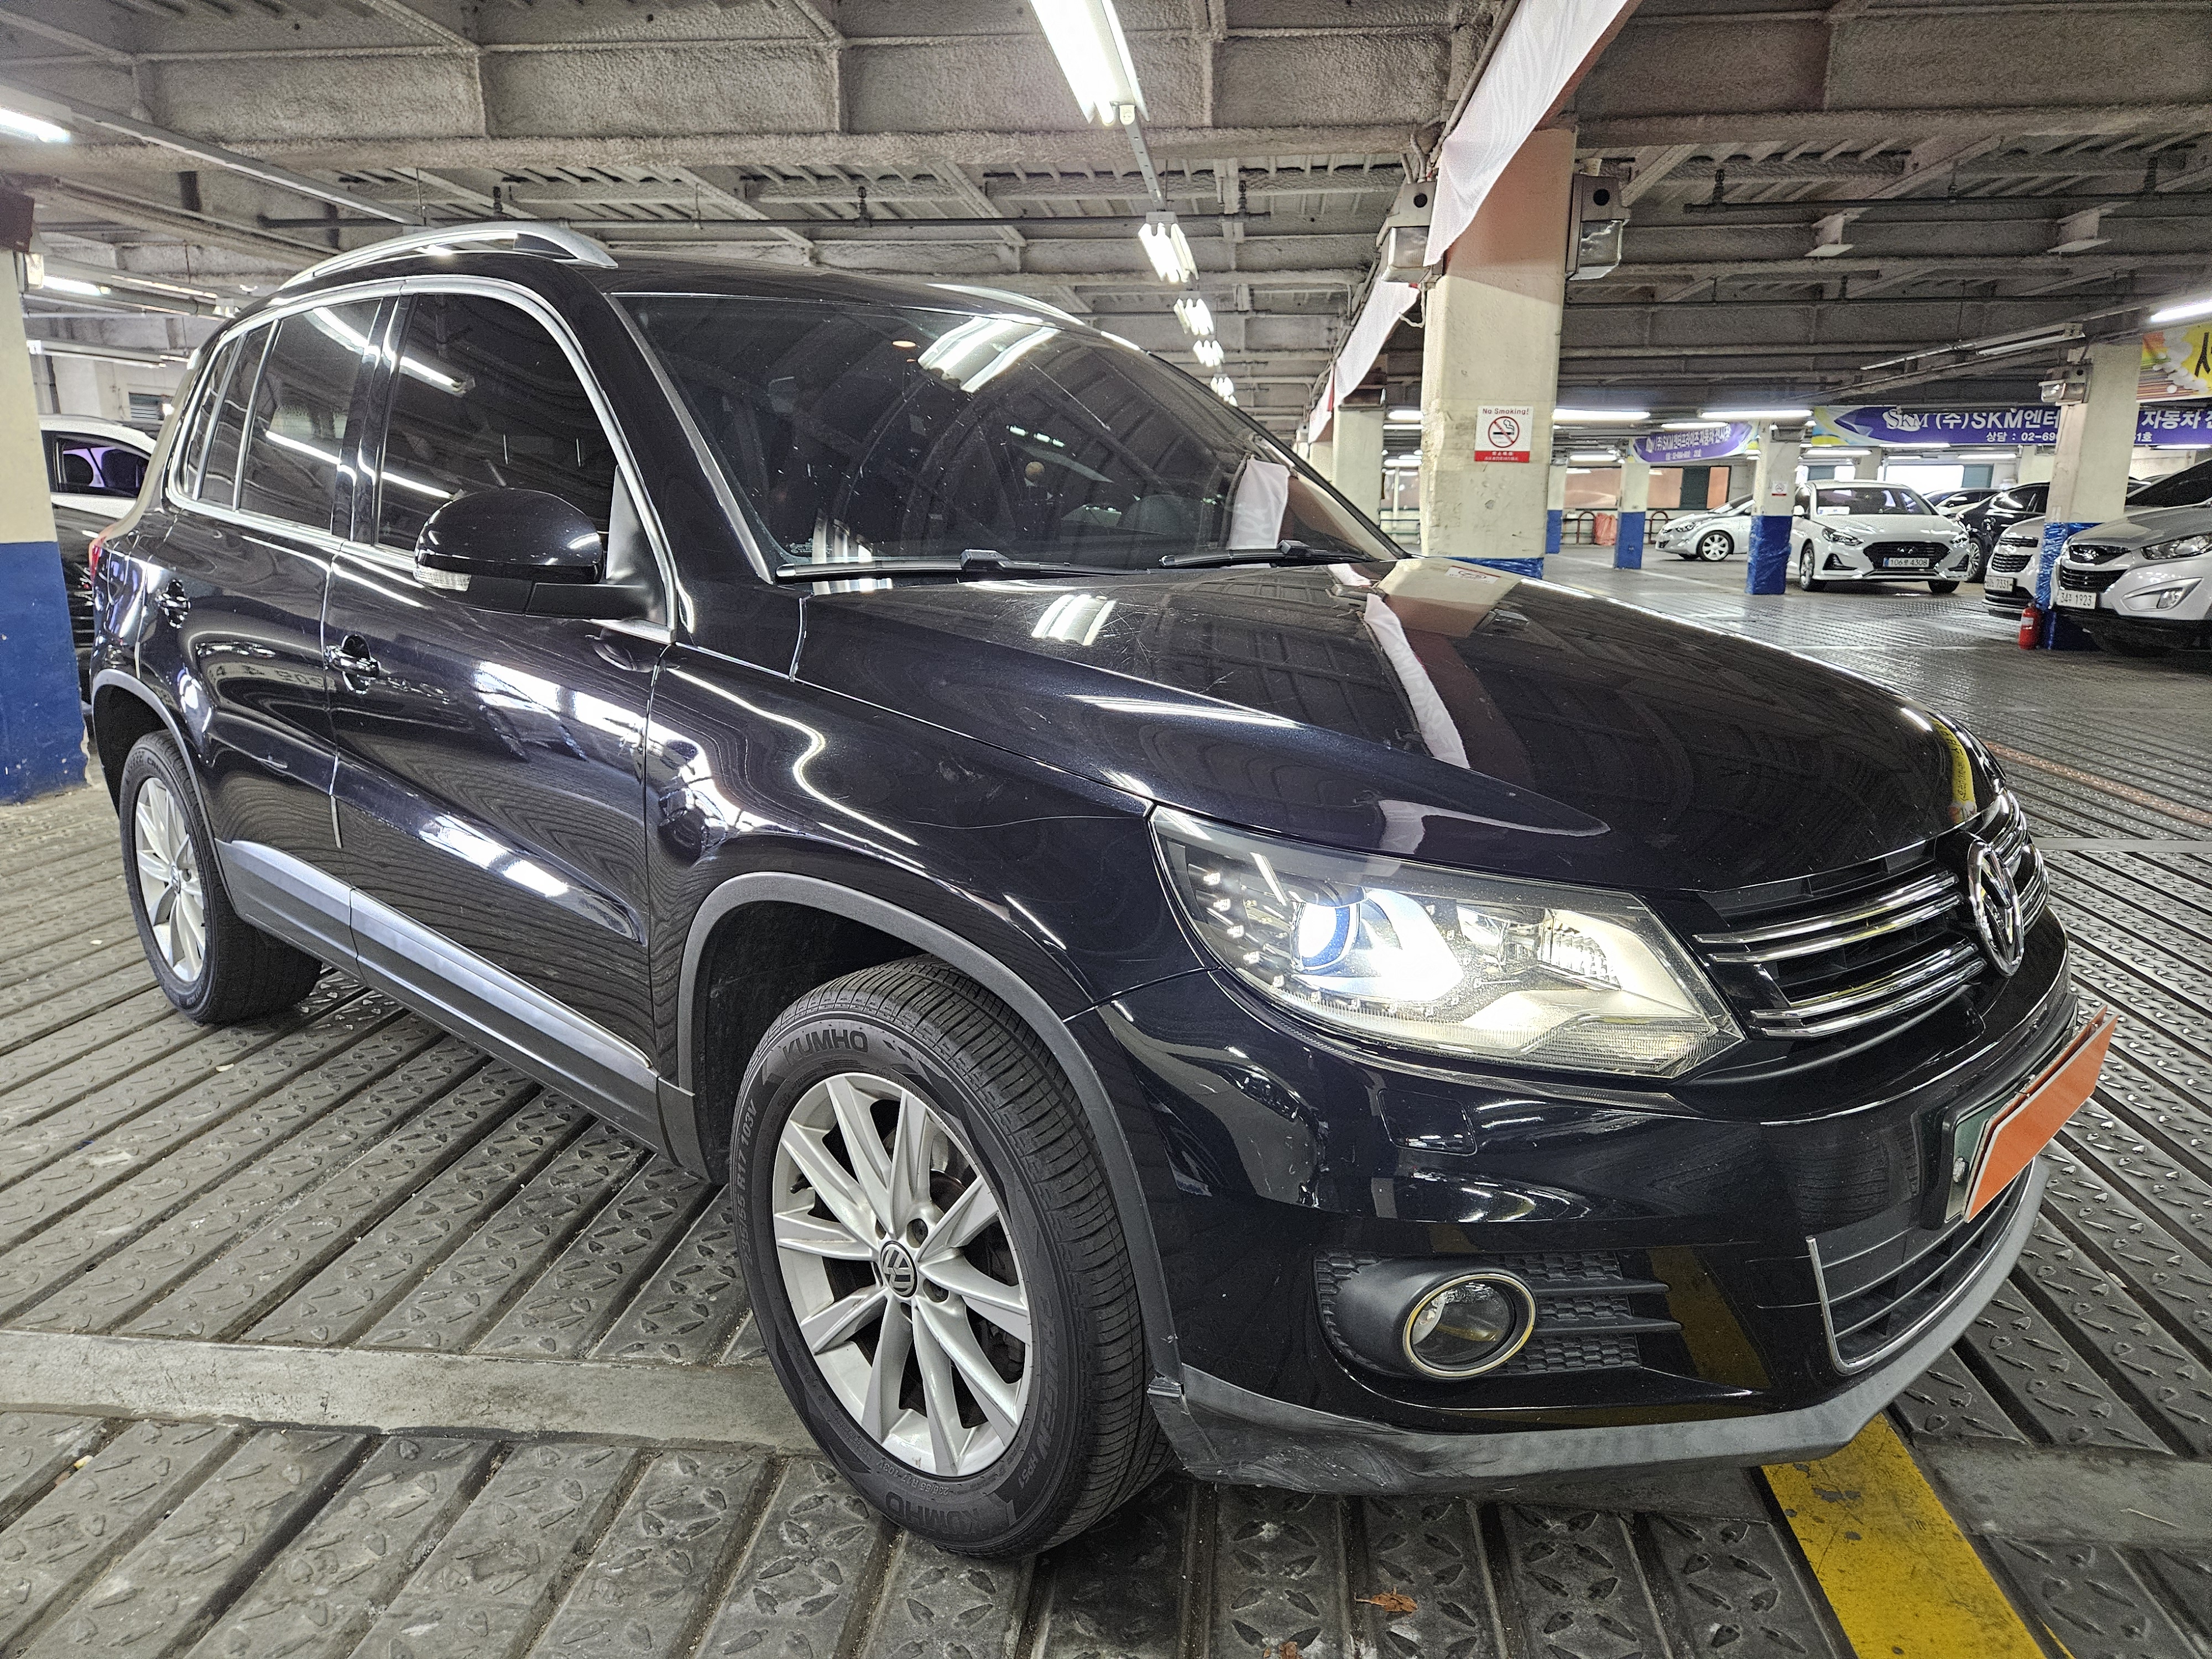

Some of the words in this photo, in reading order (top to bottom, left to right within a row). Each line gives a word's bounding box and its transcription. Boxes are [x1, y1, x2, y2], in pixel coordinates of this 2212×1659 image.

[1986, 431, 2007, 442] 상담
[2021, 431, 2058, 442] 02-69
[2075, 593, 2092, 606] 1923
[782, 1029, 869, 1066] KUMHO
[741, 1099, 757, 1146] 103V
